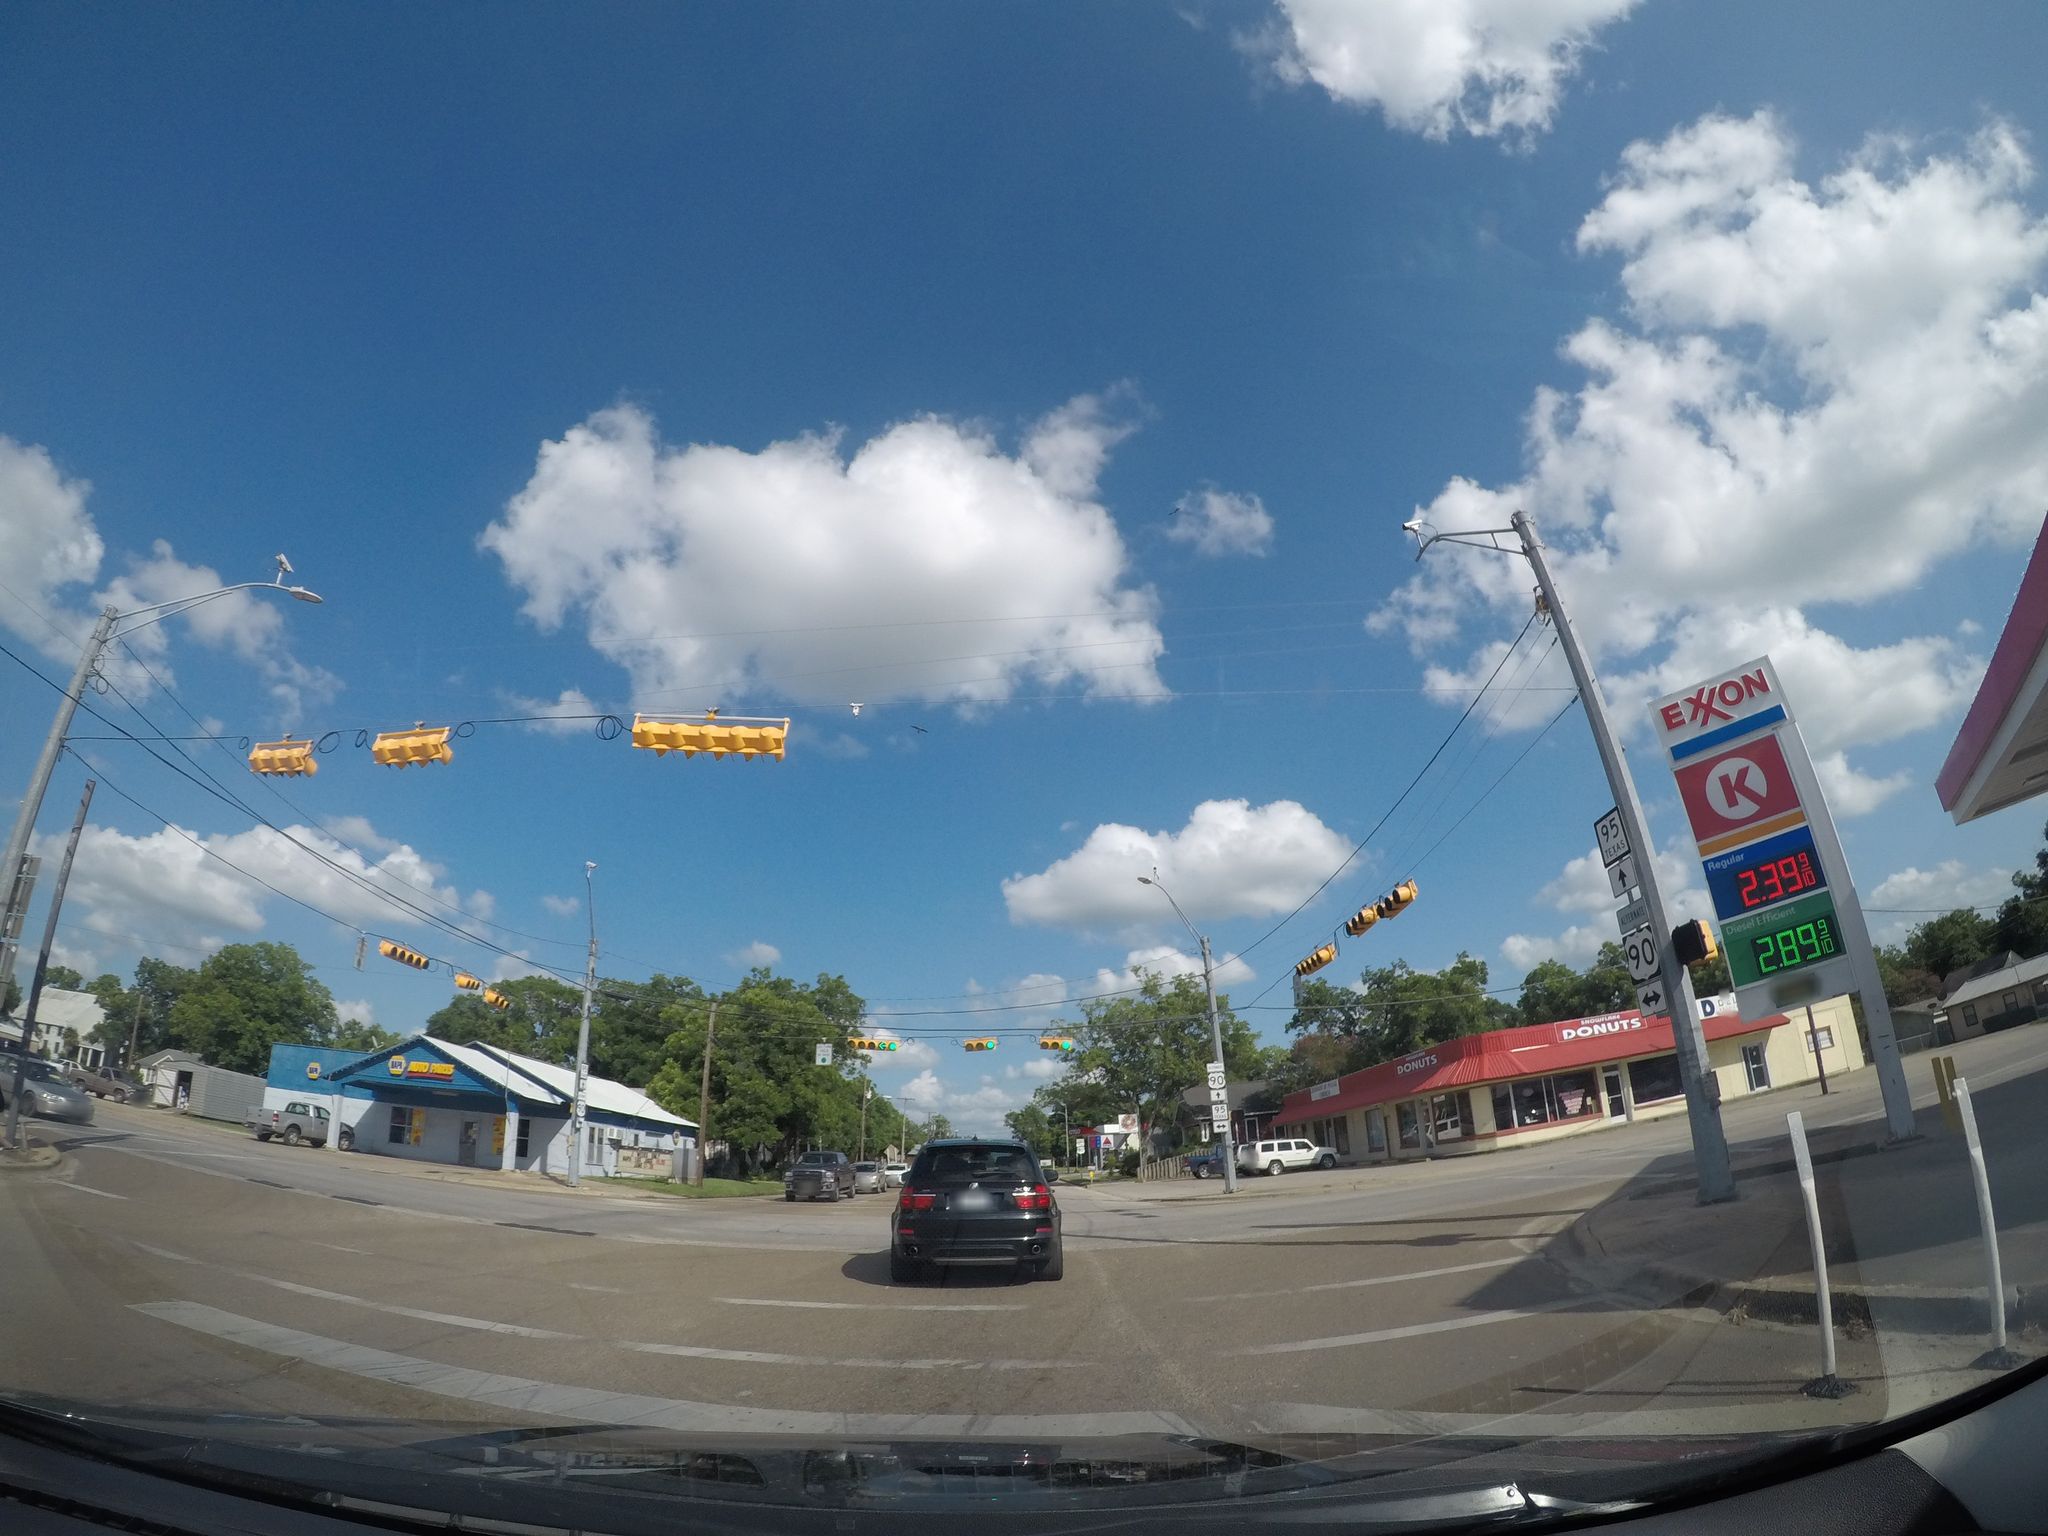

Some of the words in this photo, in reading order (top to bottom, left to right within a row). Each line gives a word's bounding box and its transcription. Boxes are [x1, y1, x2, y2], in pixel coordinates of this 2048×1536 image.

[1660, 668, 1771, 731] EXXON
[1718, 765, 1768, 808] K
[1601, 817, 1619, 843] 95
[1605, 841, 1626, 859] TEXAS
[1707, 853, 1745, 871] Regular
[1620, 906, 1645, 926] ALTERNATE
[1725, 919, 1754, 935] Diesel
[1756, 906, 1797, 925] Efficient
[1628, 937, 1655, 970] 90
[1562, 1017, 1642, 1041] DONUTS
[1396, 1054, 1438, 1075] DONUTS
[1209, 1075, 1224, 1086] 90
[1214, 1105, 1226, 1114] 95
